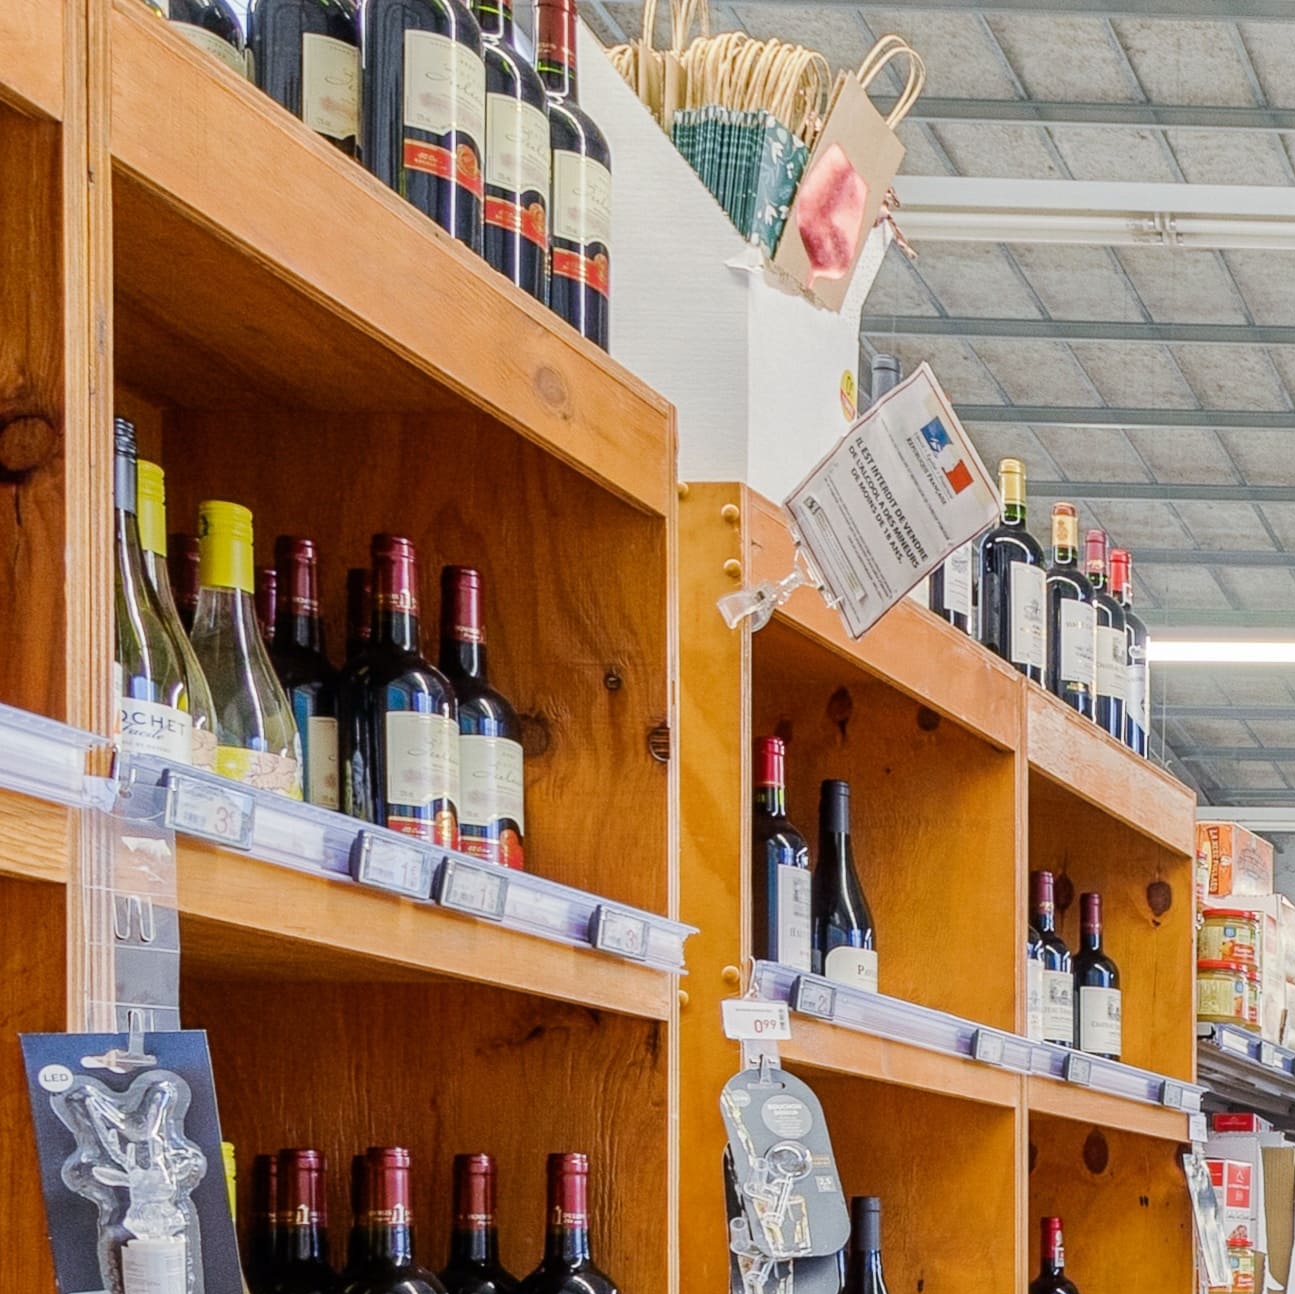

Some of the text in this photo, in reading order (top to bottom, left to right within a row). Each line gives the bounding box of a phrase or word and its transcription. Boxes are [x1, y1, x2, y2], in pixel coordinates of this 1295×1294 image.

[856, 478, 877, 514] MOINS
[870, 462, 898, 508] INTERDIT
[903, 521, 929, 560] VENDRE
[892, 524, 920, 569] MINEURS
[44, 1073, 68, 1082] LED
